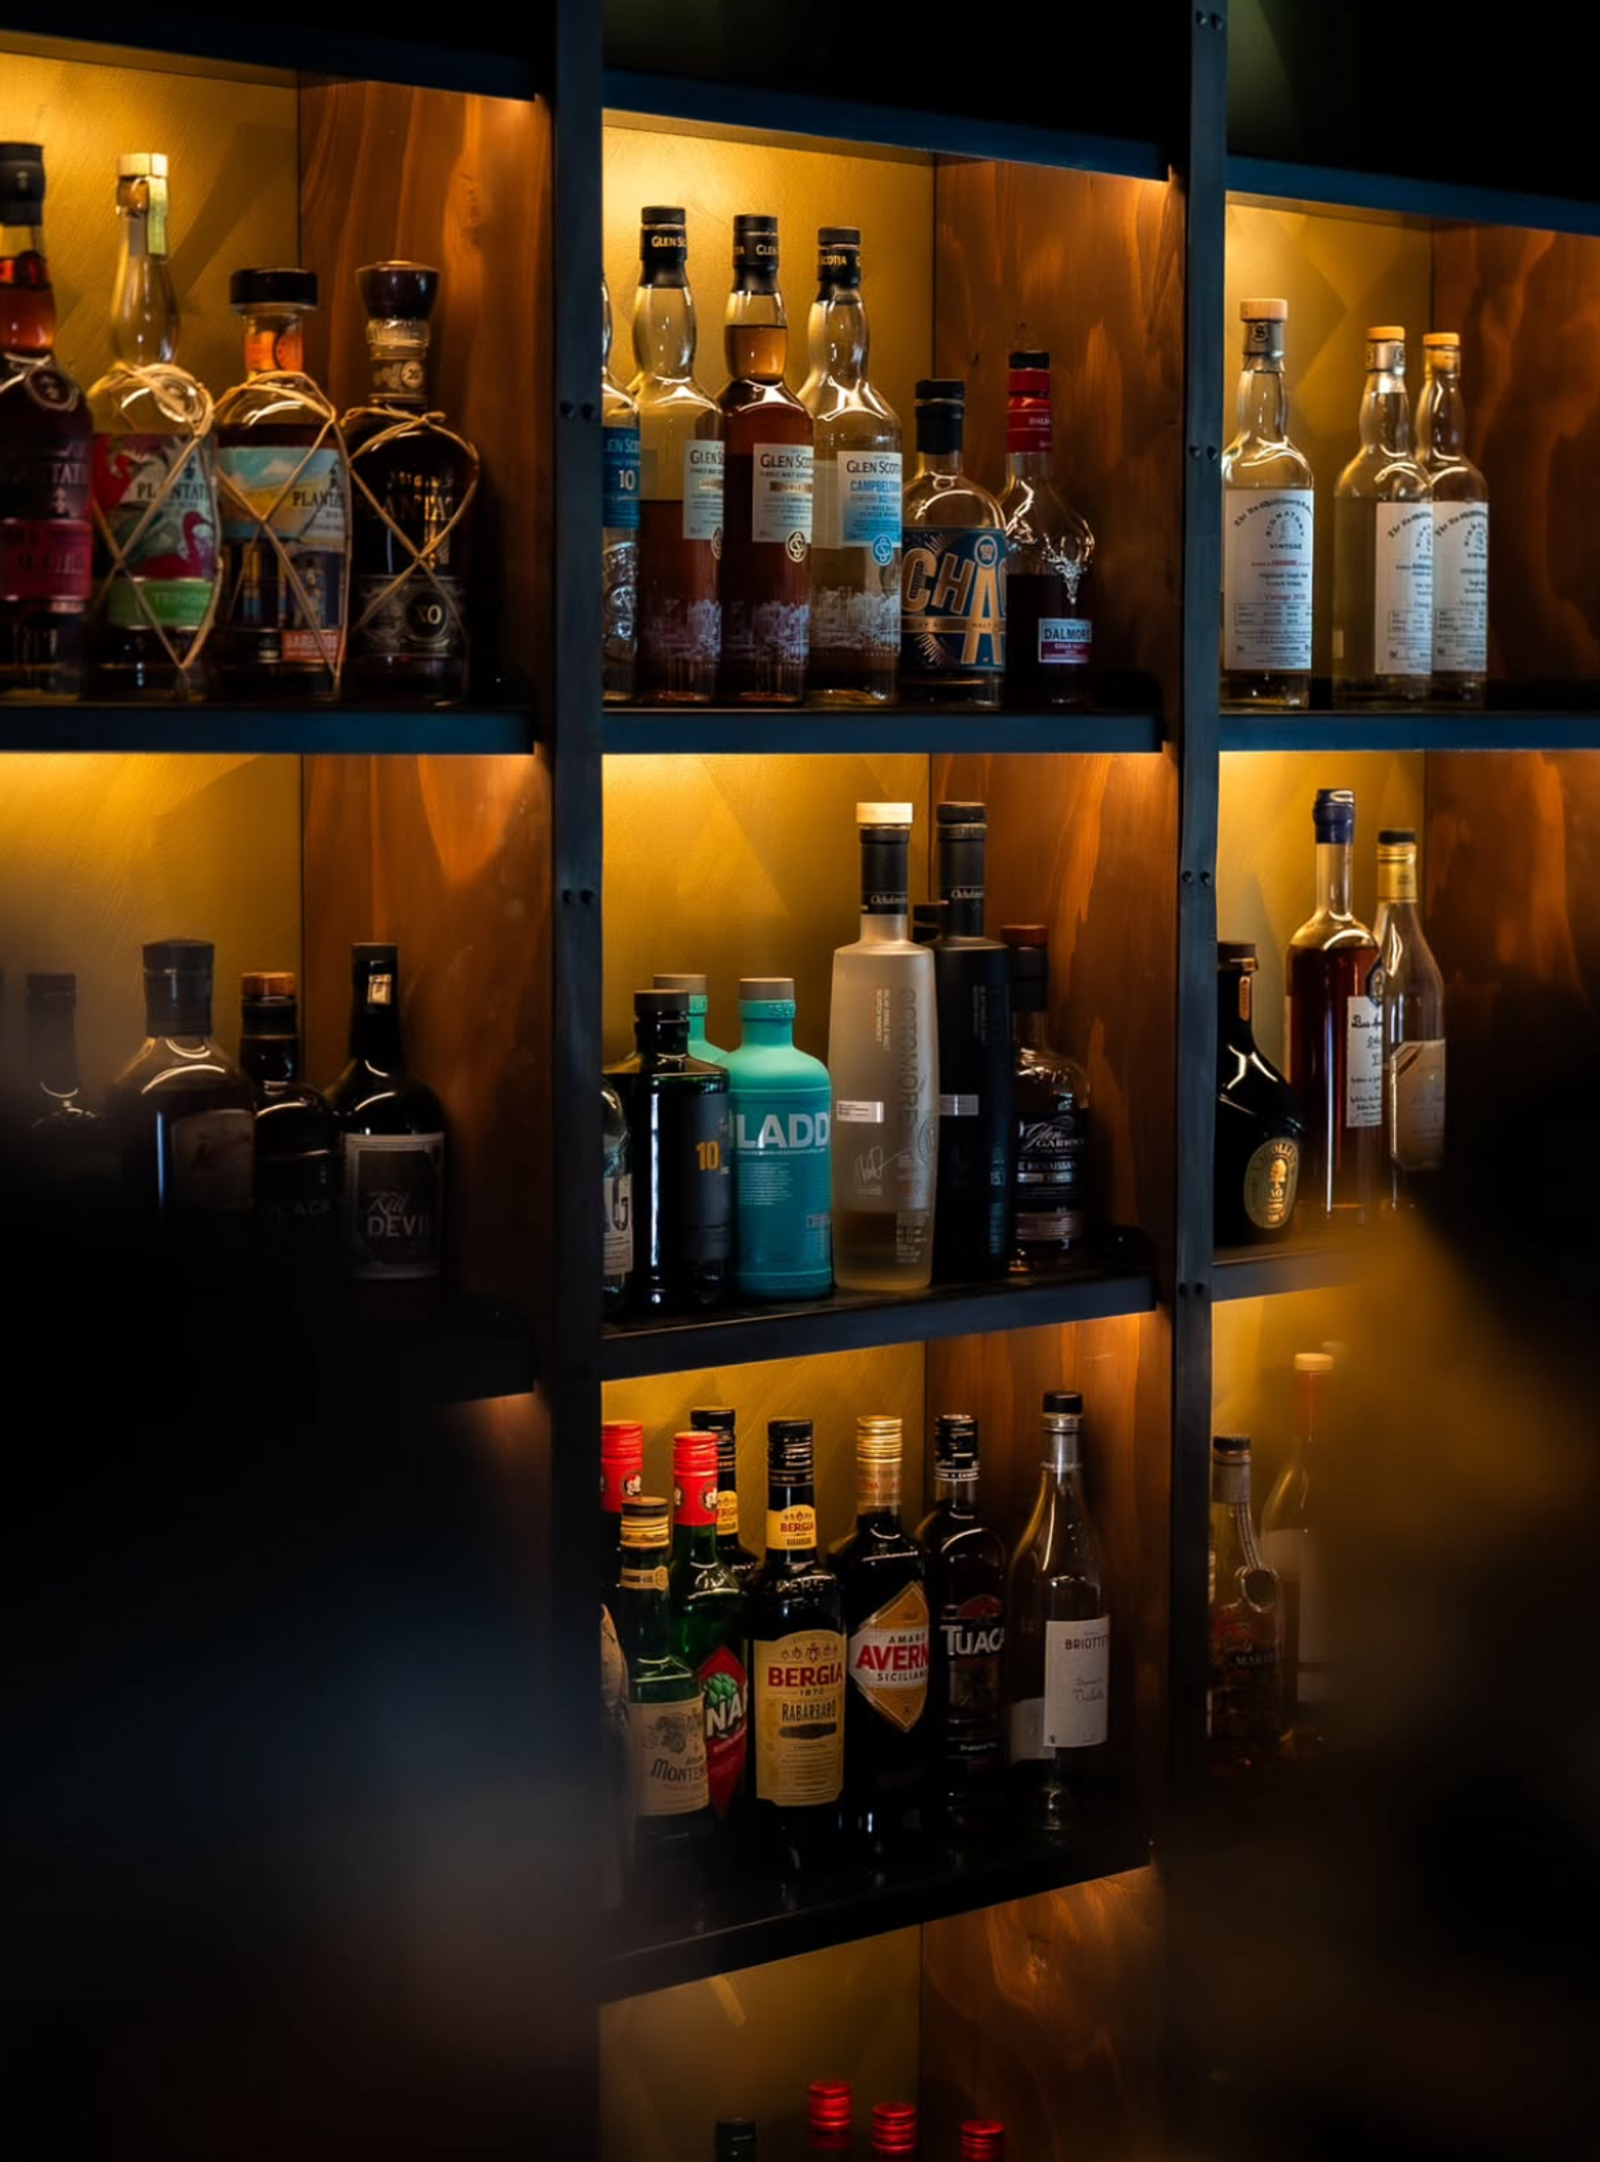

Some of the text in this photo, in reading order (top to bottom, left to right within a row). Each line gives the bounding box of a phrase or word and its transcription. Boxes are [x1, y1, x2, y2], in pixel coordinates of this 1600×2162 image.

[690, 449, 715, 464] GLEN
[760, 453, 794, 468] GLEN
[846, 460, 877, 473] GLEN
[618, 469, 637, 492] 10
[1265, 511, 1305, 538] SIGNATORY
[902, 547, 1007, 665] CHA
[899, 987, 919, 1123] OCTOMORE
[736, 1112, 830, 1149] LADD
[695, 1140, 720, 1170] 10
[940, 1623, 1004, 1656] TUAC
[767, 1662, 843, 1687] BERGIA
[877, 1669, 926, 1682] SICILIAN
[782, 1700, 837, 1722] RABARBARO
